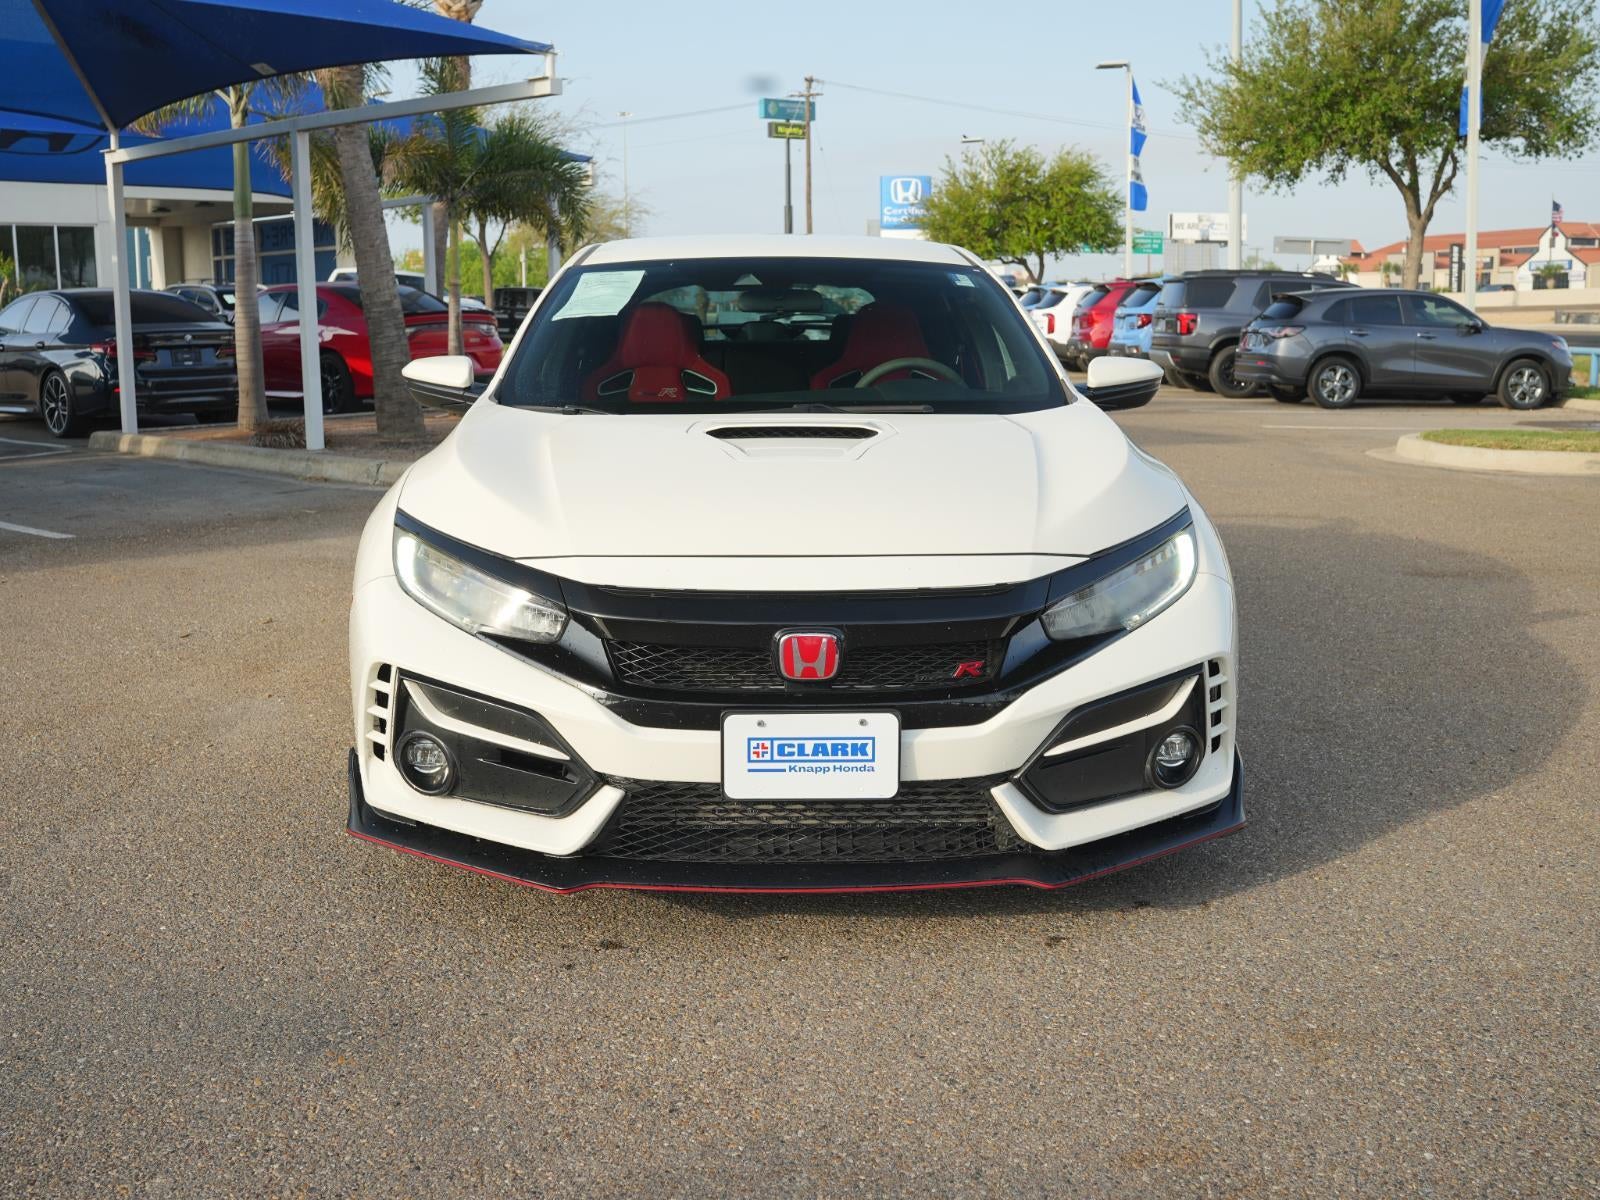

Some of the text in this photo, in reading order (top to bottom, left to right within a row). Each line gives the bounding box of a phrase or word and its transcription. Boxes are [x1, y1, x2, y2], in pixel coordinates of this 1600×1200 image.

[776, 742, 870, 757] CLARK
[788, 764, 876, 775] Knapp Honda
